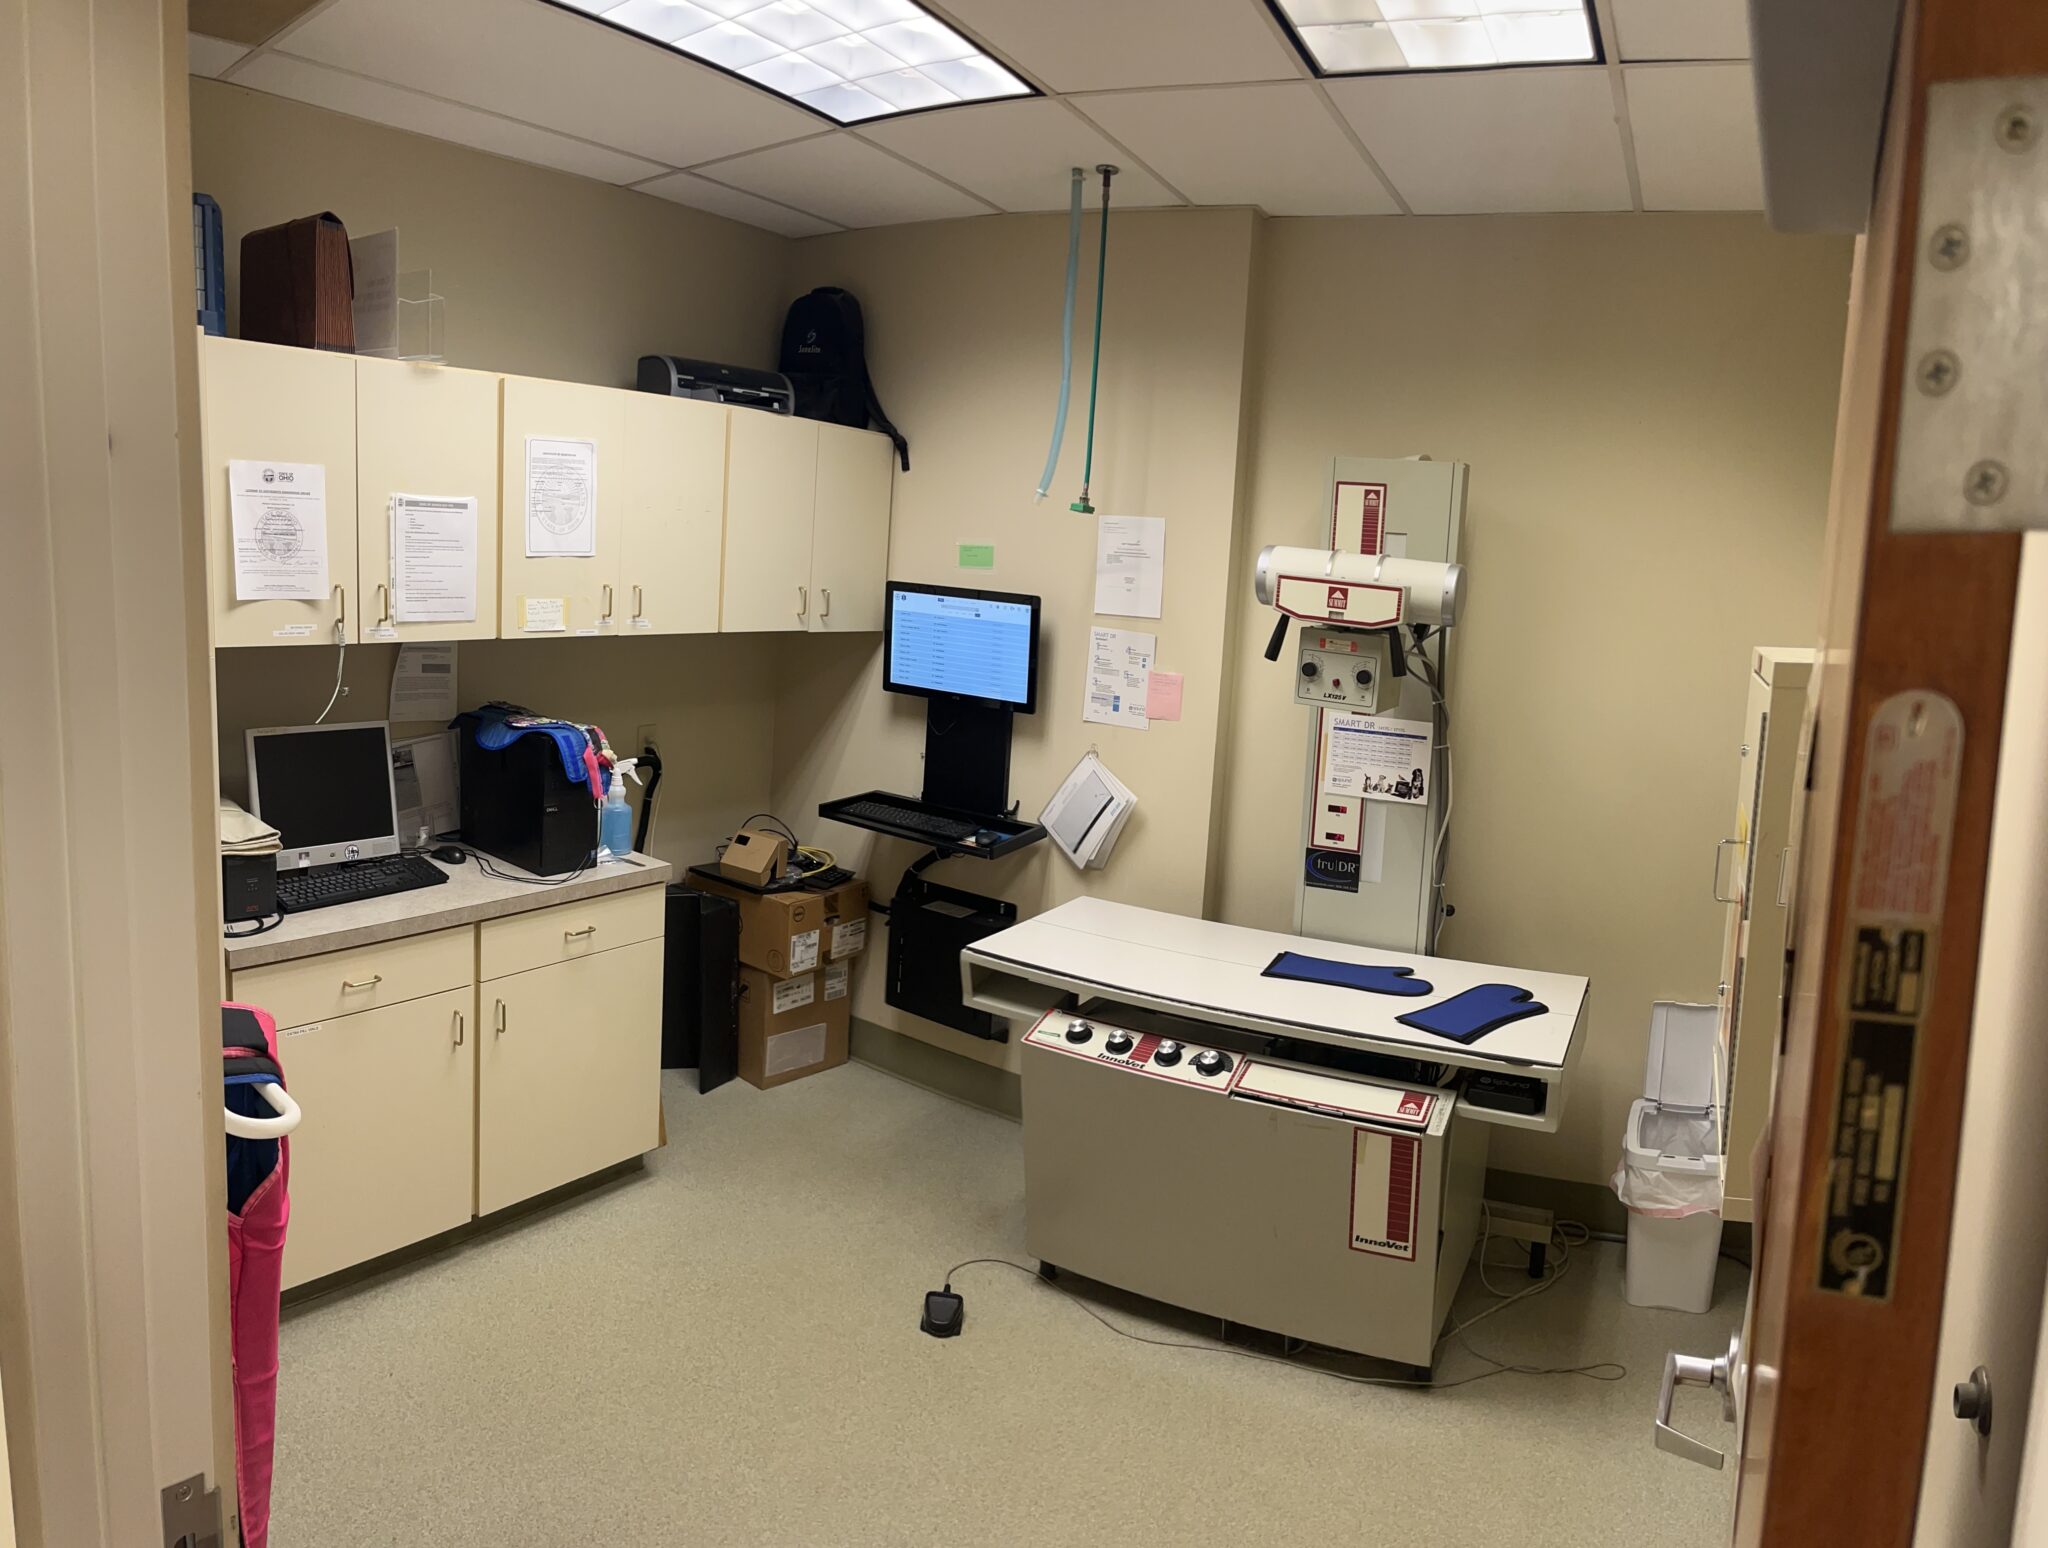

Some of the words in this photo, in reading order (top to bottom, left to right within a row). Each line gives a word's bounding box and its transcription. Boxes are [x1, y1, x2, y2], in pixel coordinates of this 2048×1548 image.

[1328, 598, 1346, 609] SUMMIT
[1334, 717, 1362, 729] SMART
[1364, 721, 1376, 730] DR
[1097, 1053, 1146, 1069] InnoVet
[1354, 1235, 1410, 1252] InnoVet
